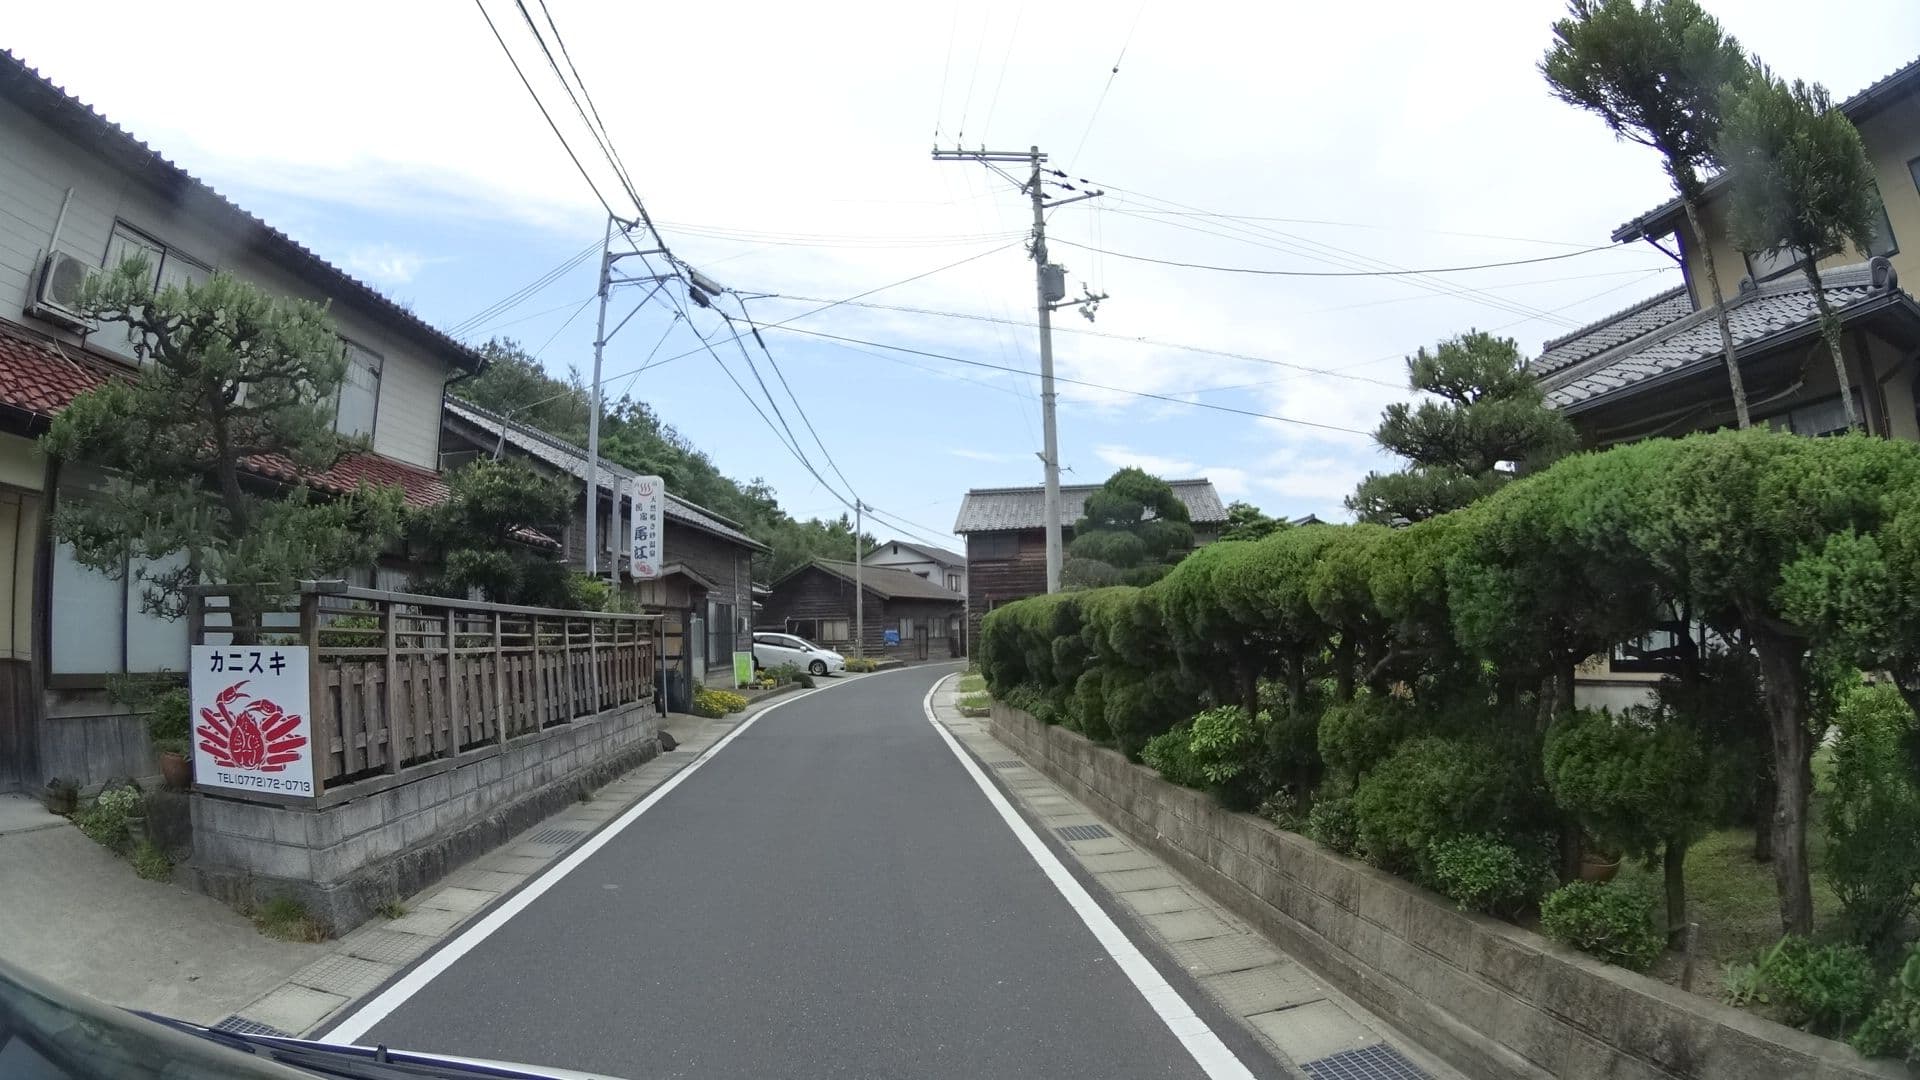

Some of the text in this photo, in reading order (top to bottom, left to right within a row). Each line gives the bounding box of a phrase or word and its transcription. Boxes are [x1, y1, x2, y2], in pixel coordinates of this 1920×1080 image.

[210, 650, 286, 676] カニスキ
[217, 772, 311, 792] TEL(0772)72-0713
